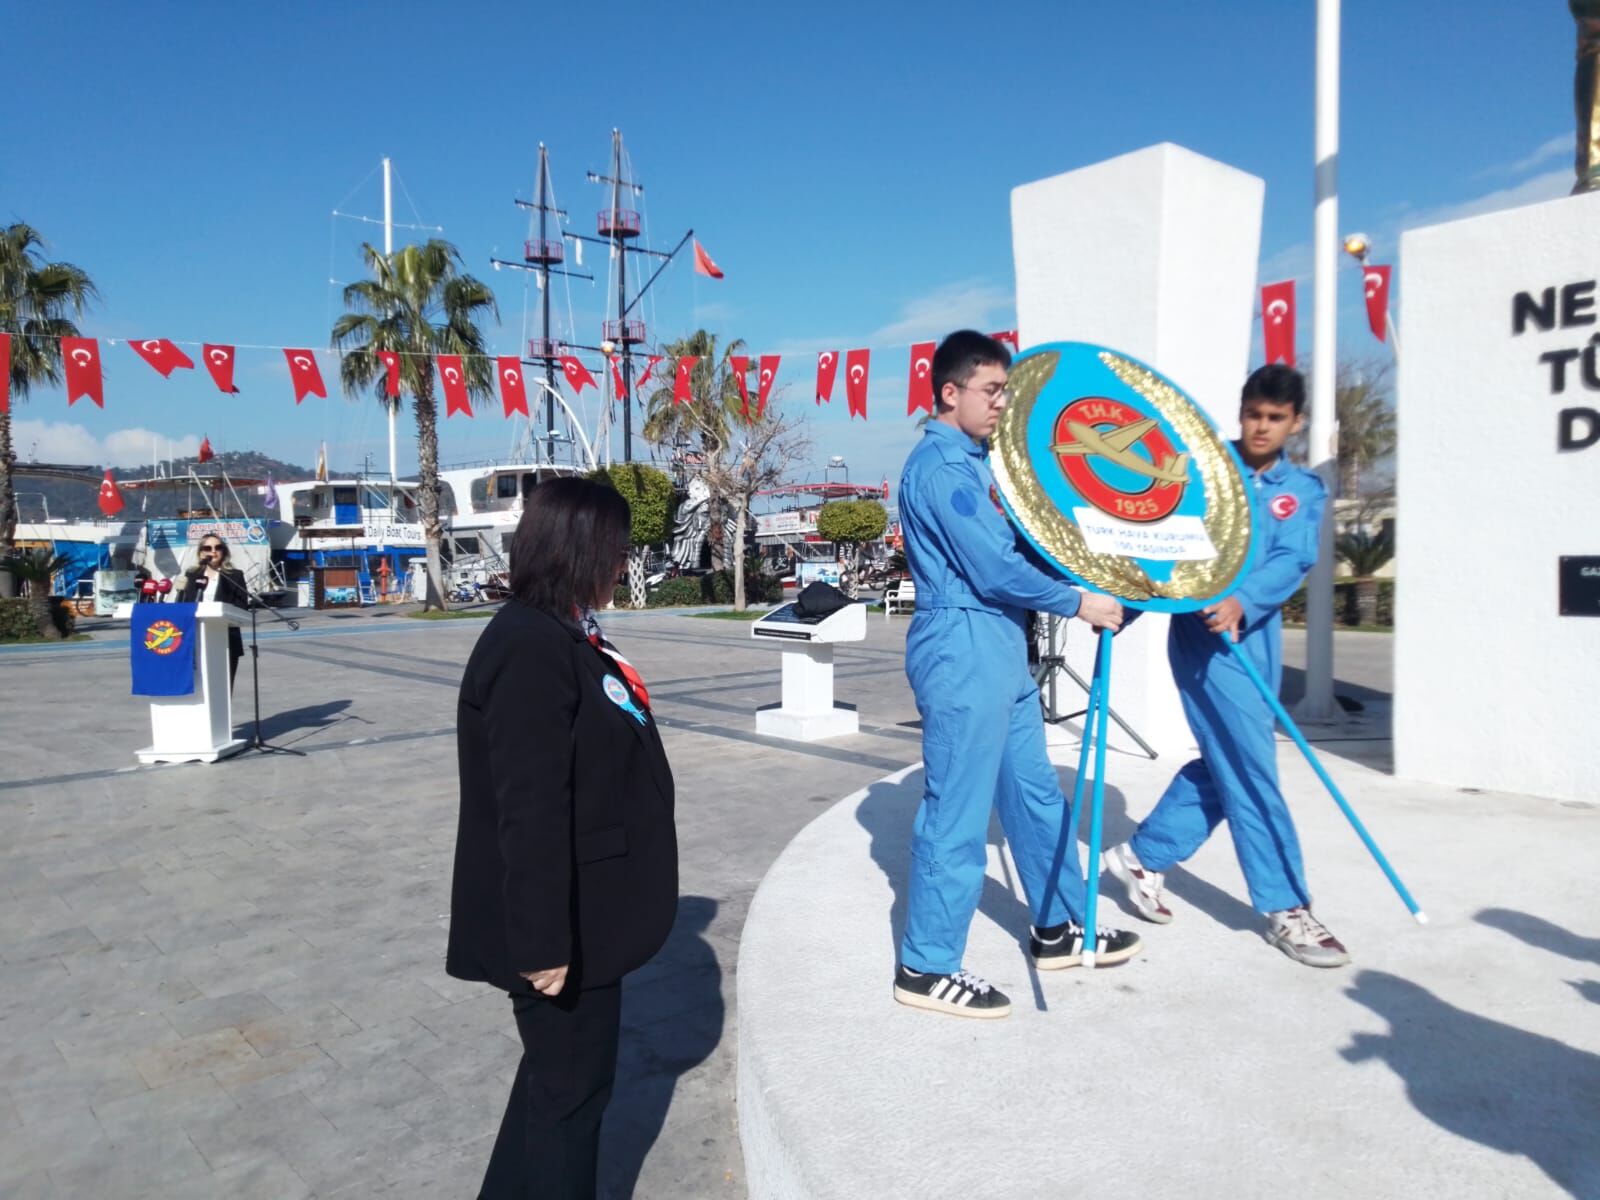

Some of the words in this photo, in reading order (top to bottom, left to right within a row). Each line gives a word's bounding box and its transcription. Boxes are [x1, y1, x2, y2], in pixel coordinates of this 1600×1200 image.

[1512, 279, 1597, 336] NE
[1114, 498, 1159, 515] 1925
[368, 526, 385, 543] Daily
[386, 526, 402, 538] Boat
[403, 527, 421, 540] Tours
